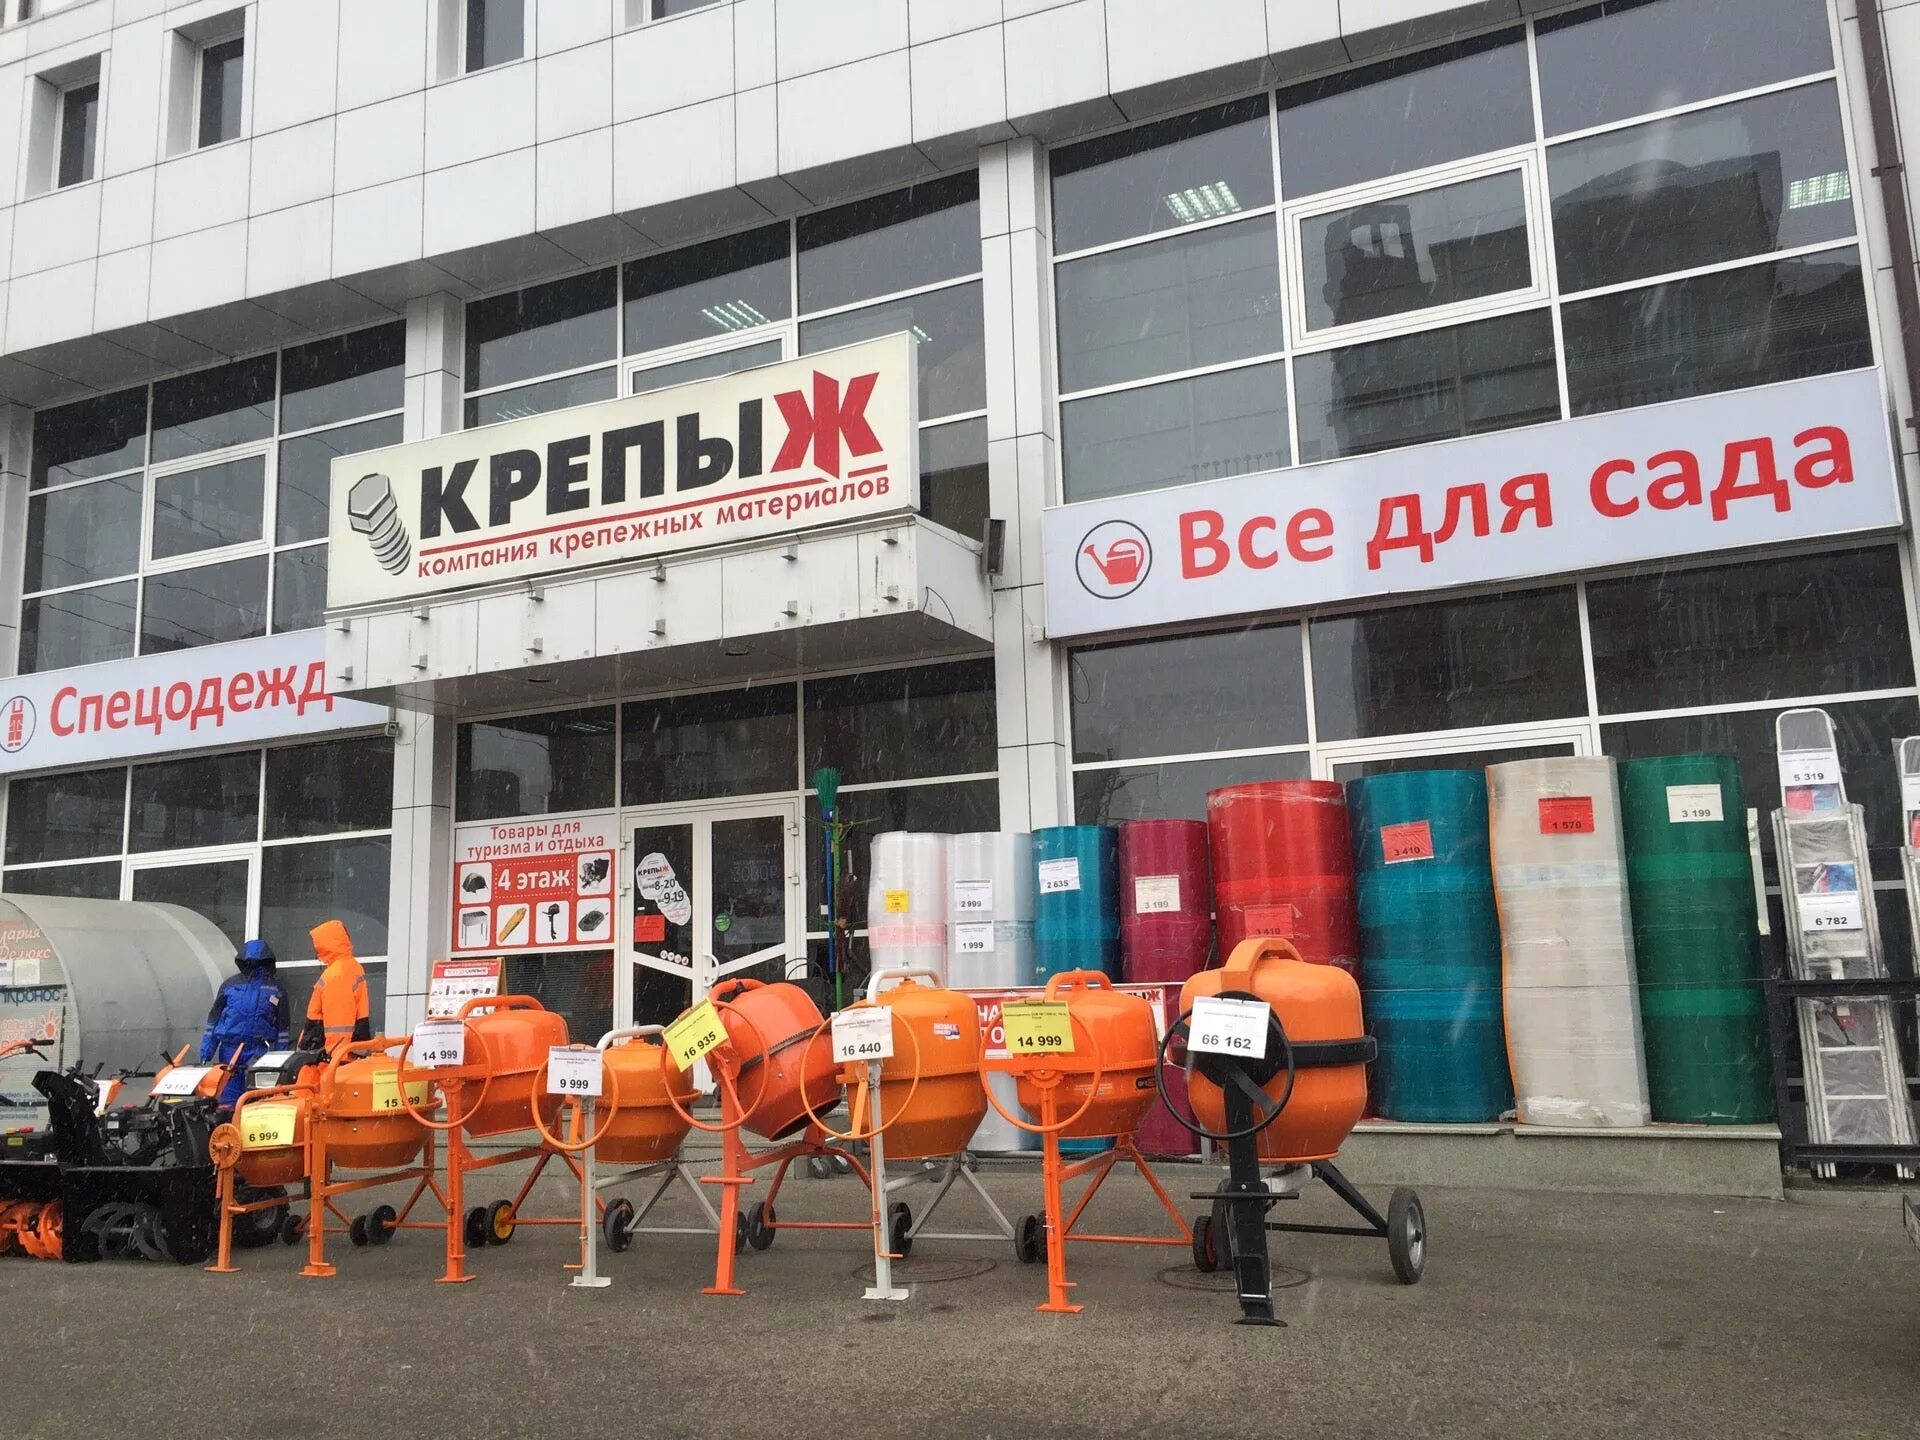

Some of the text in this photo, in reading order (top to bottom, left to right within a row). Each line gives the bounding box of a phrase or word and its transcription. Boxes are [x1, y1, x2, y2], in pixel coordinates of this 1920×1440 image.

[420, 370, 884, 540] КРЕПЫЖ
[1178, 425, 1855, 580] Все для сада
[417, 473, 891, 578] компания крепежных материалов
[50, 661, 334, 737] Спецодежд
[1804, 773, 1824, 781] 319
[1693, 809, 1711, 817] 199
[490, 821, 581, 841] Товары для
[1562, 821, 1582, 830] 570
[468, 835, 604, 861] туризма и отдыха
[638, 864, 670, 876] КРЕПЫЖ
[497, 868, 571, 891] 4 этаж
[1826, 917, 1848, 925] 782
[683, 1031, 717, 1060] 16 935
[1017, 1035, 1062, 1047] 14 999
[1201, 1034, 1252, 1050] 66 162
[422, 1049, 458, 1061] 14 999
[842, 1042, 881, 1056] 16 440
[560, 1079, 589, 1090] 9 999
[384, 1099, 398, 1107] 15
[249, 1131, 279, 1142] 6 999
